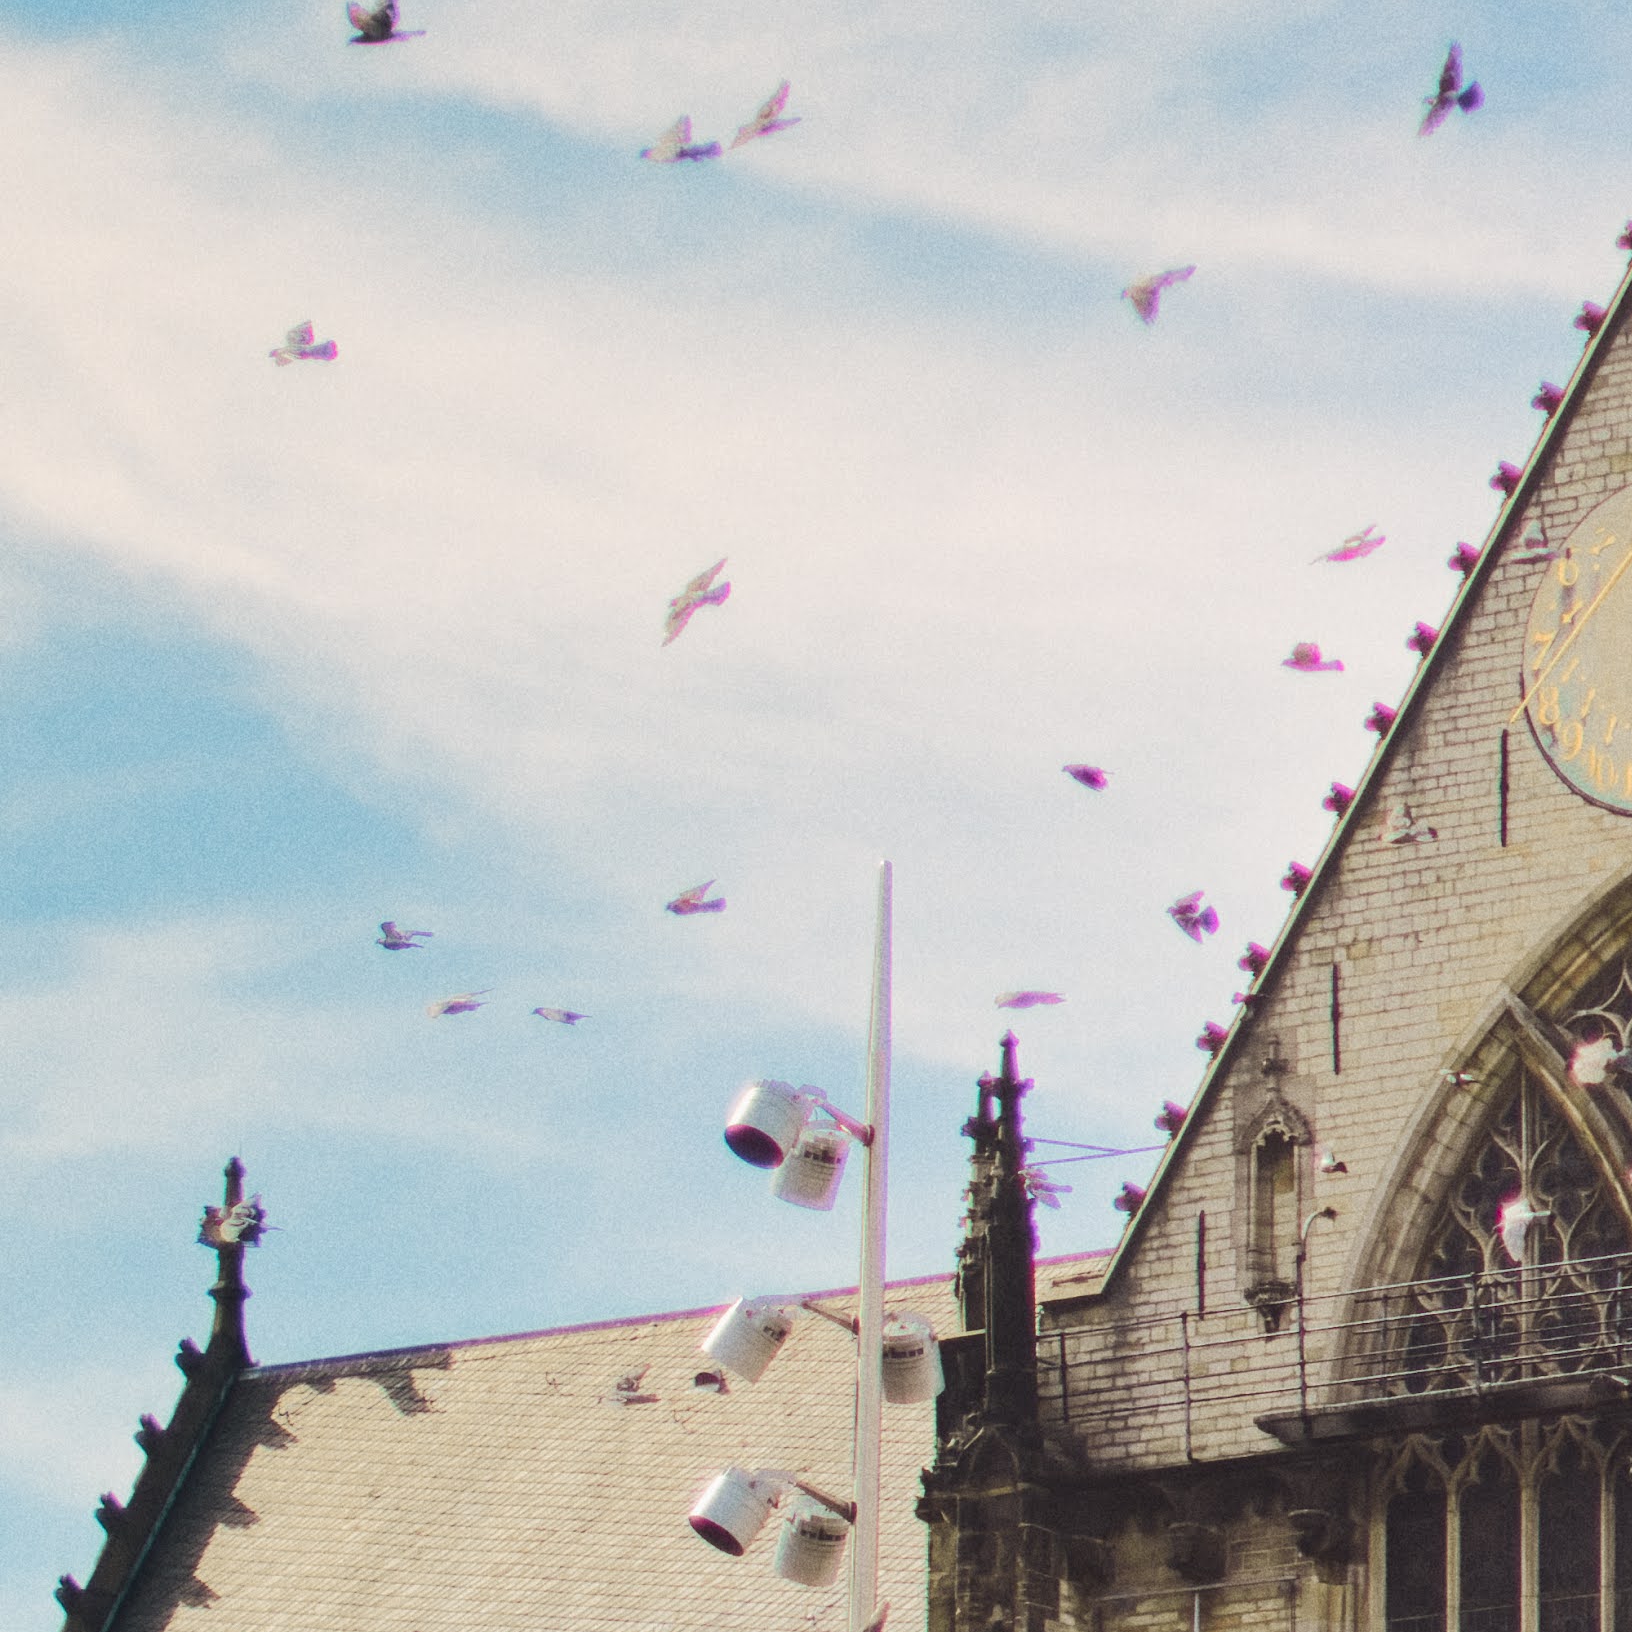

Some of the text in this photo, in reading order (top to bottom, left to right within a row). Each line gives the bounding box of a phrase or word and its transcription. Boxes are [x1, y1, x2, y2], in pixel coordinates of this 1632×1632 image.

[1532, 630, 1557, 671] 7
[1538, 686, 1560, 725] 8
[1561, 720, 1584, 761] 9
